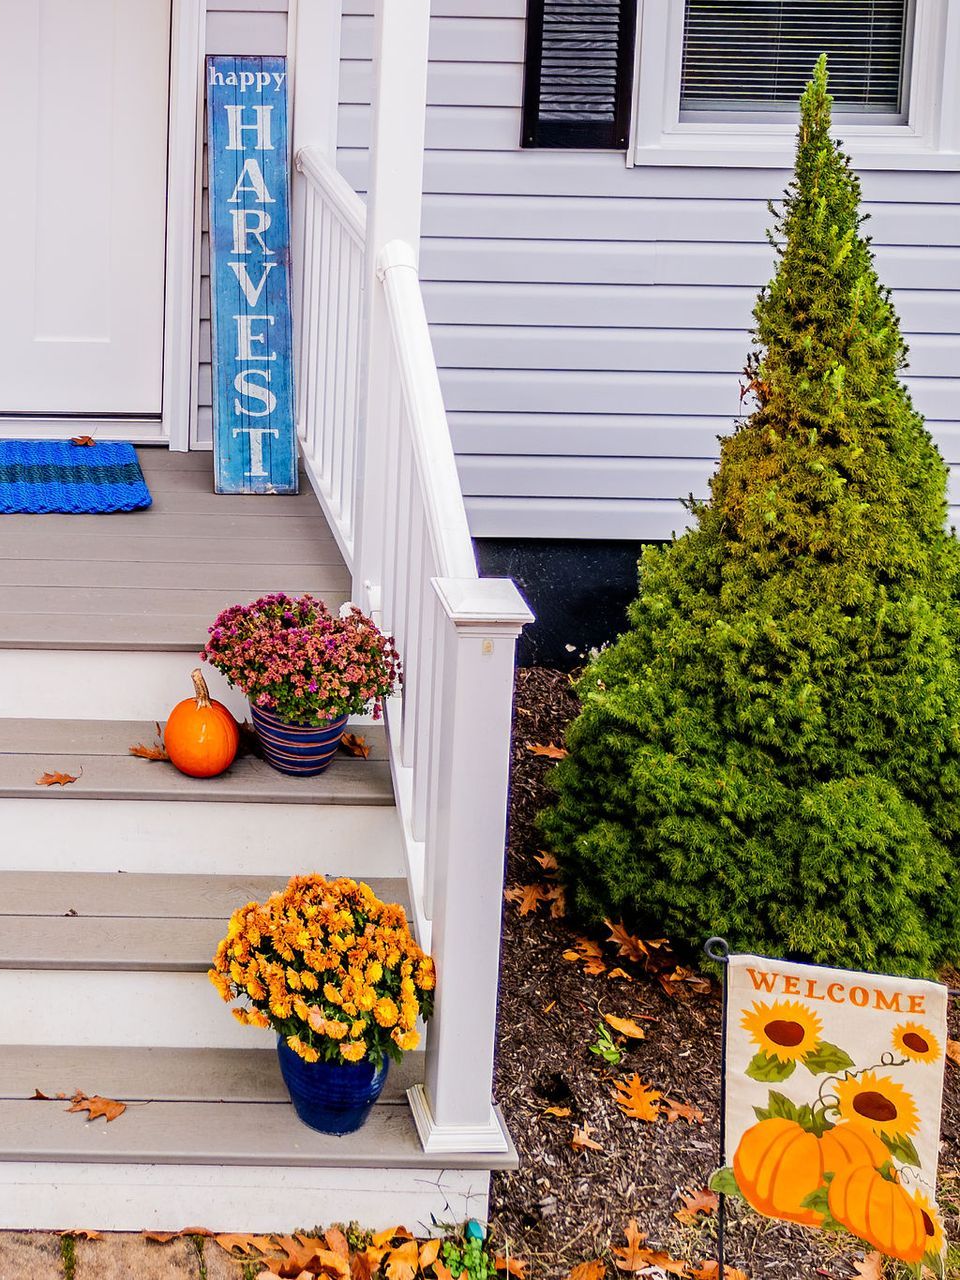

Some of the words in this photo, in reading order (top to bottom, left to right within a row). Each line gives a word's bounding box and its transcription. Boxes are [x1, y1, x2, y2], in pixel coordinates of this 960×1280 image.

[209, 67, 286, 92] happy
[224, 105, 279, 477] HARVEST
[746, 968, 926, 1014] WELCOME
